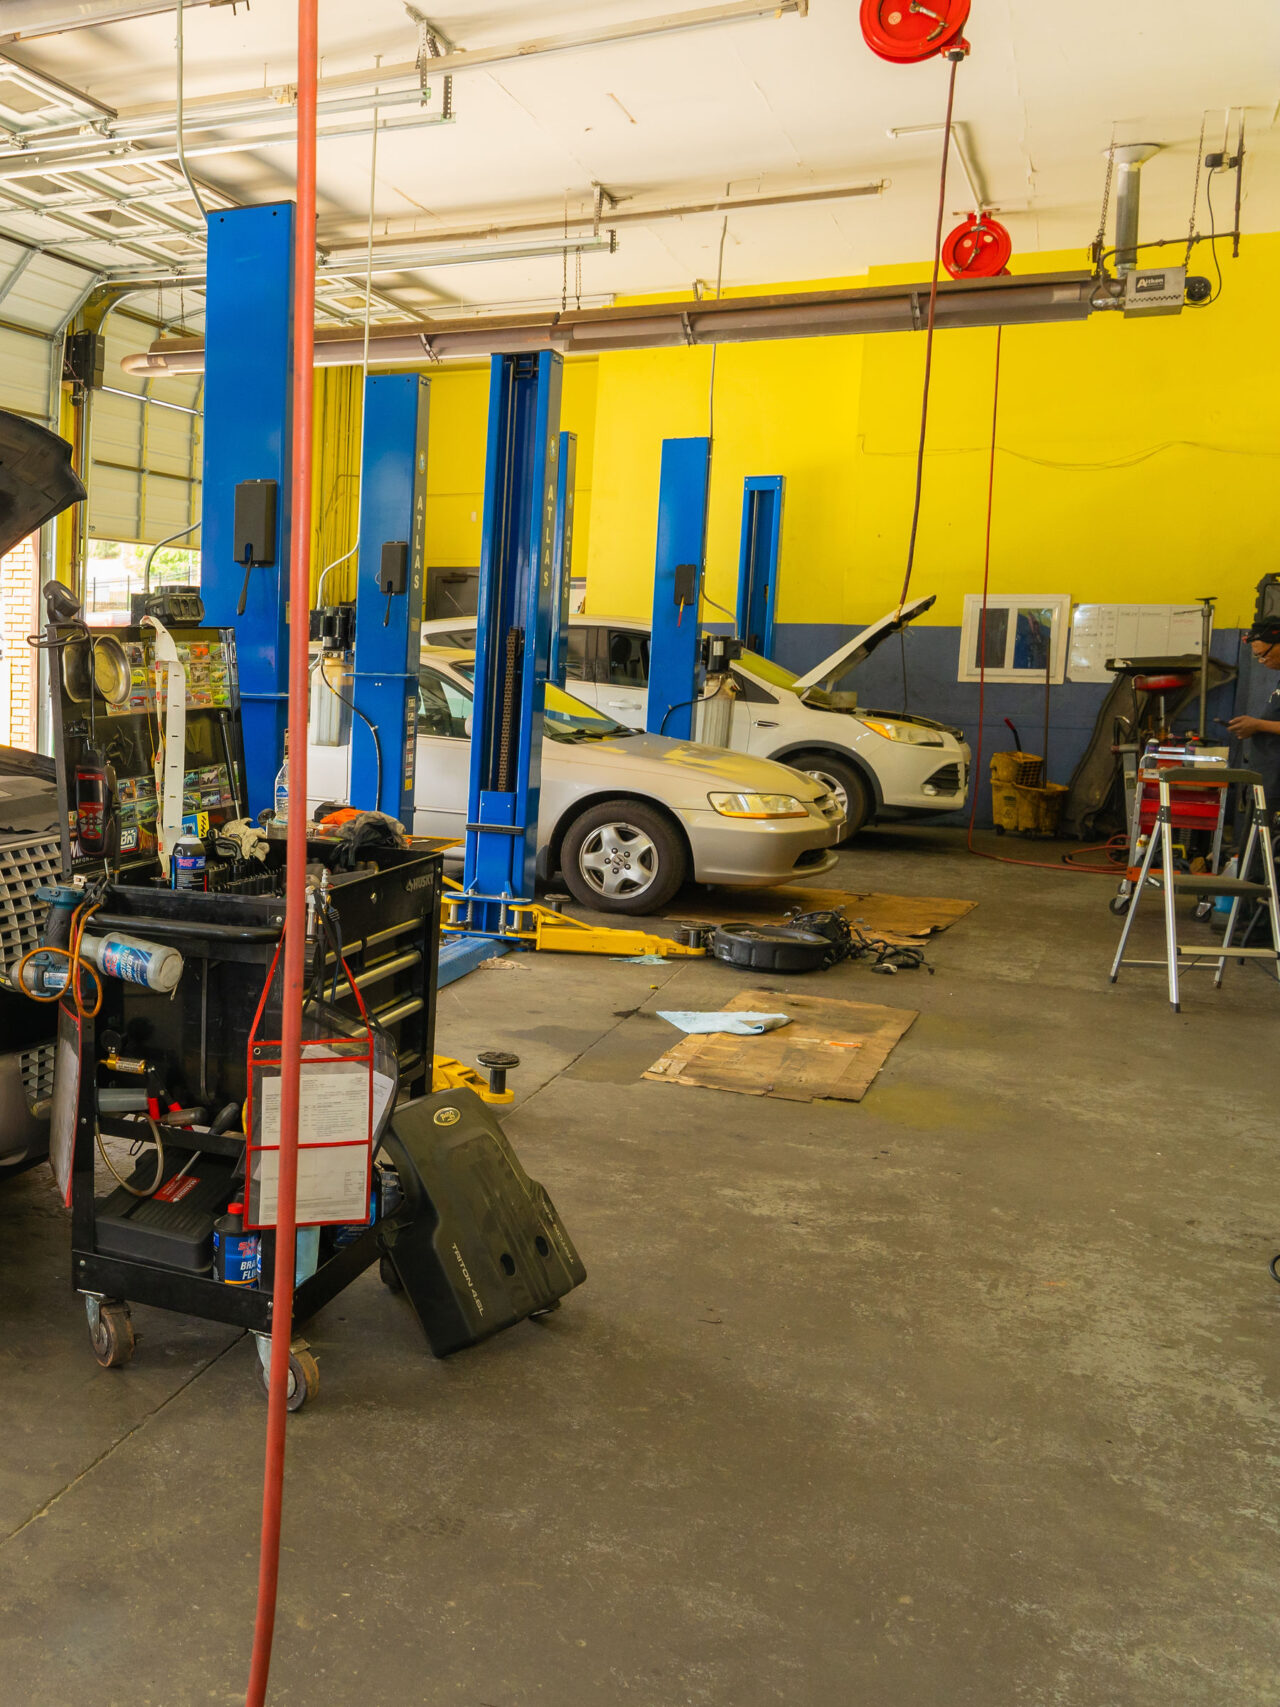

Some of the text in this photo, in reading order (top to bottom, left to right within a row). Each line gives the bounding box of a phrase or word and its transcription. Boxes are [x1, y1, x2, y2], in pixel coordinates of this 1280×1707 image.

[413, 495, 424, 589] ATLAS
[544, 484, 554, 587] ATLAS
[451, 1242, 474, 1287] TRITON
